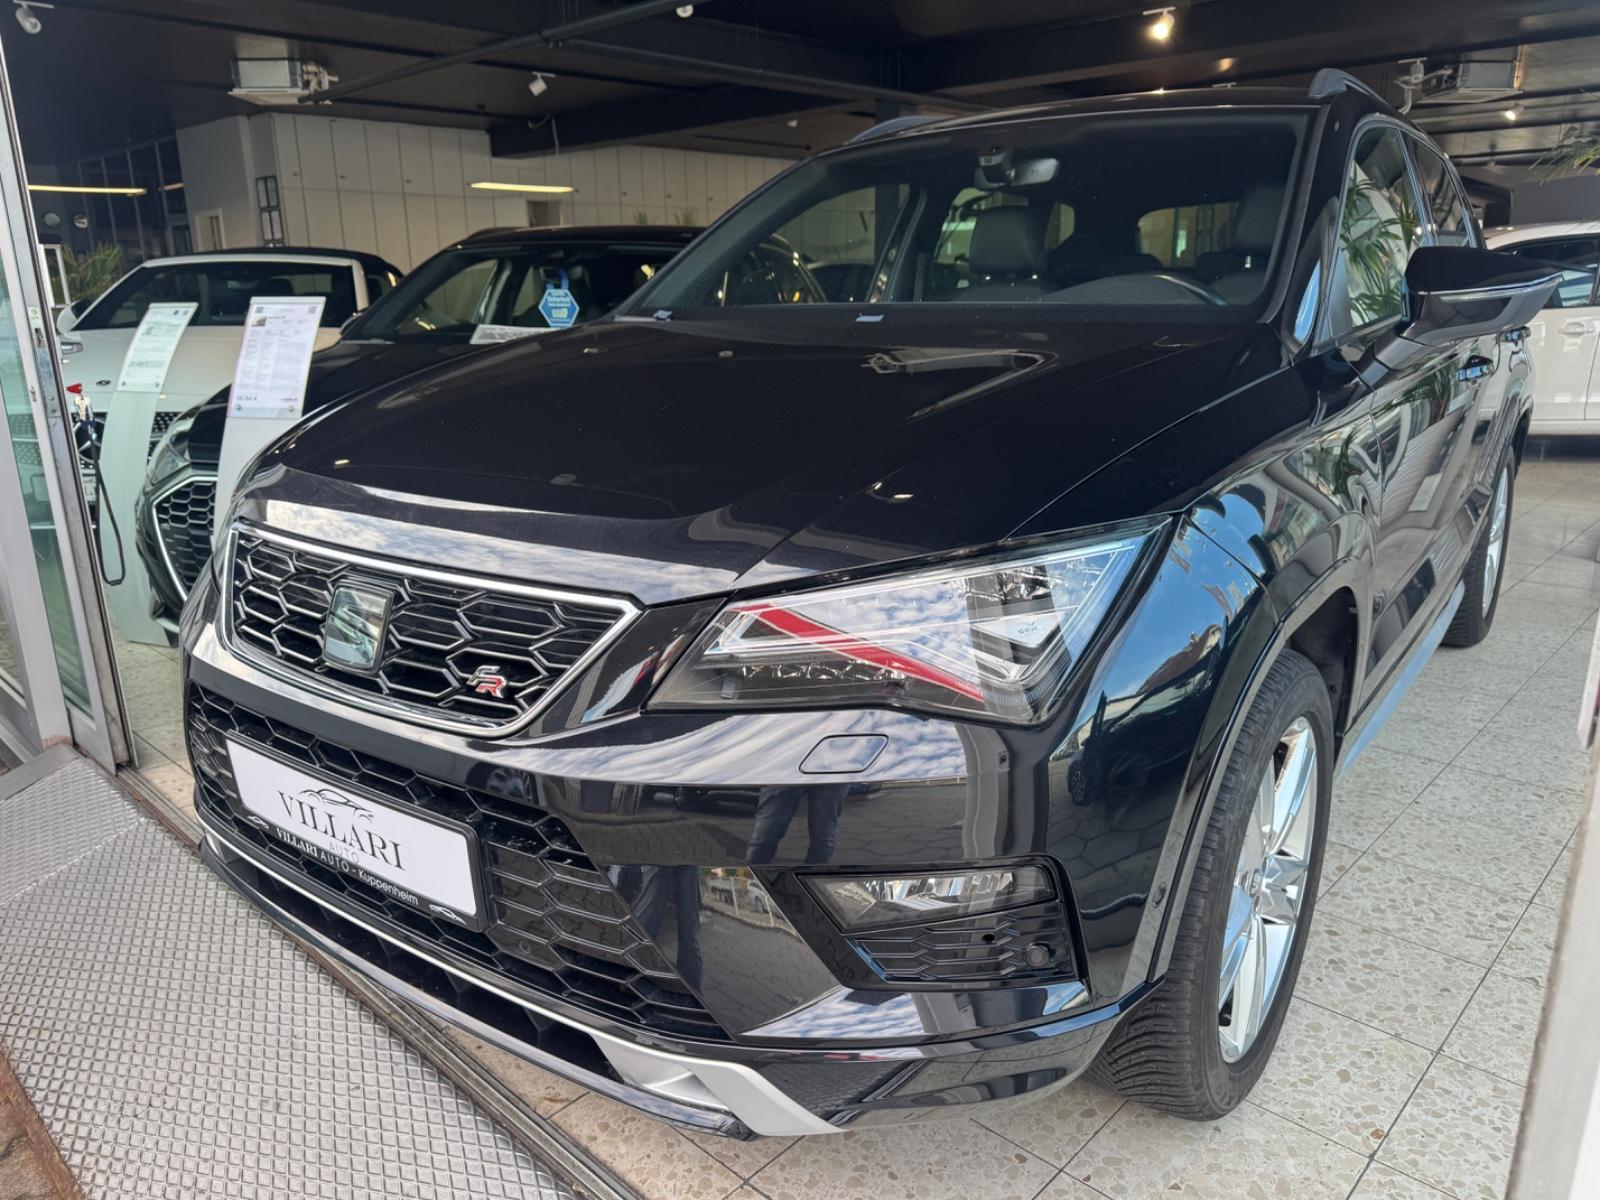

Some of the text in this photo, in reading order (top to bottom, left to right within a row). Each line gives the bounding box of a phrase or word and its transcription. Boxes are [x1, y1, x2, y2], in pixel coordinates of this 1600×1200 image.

[466, 665, 507, 699] FR
[277, 790, 406, 872] VILLARI
[328, 841, 361, 865] AUTO
[276, 828, 318, 857] VILLARI
[320, 852, 350, 873] AUTO
[358, 869, 419, 905] Kuppenheim
